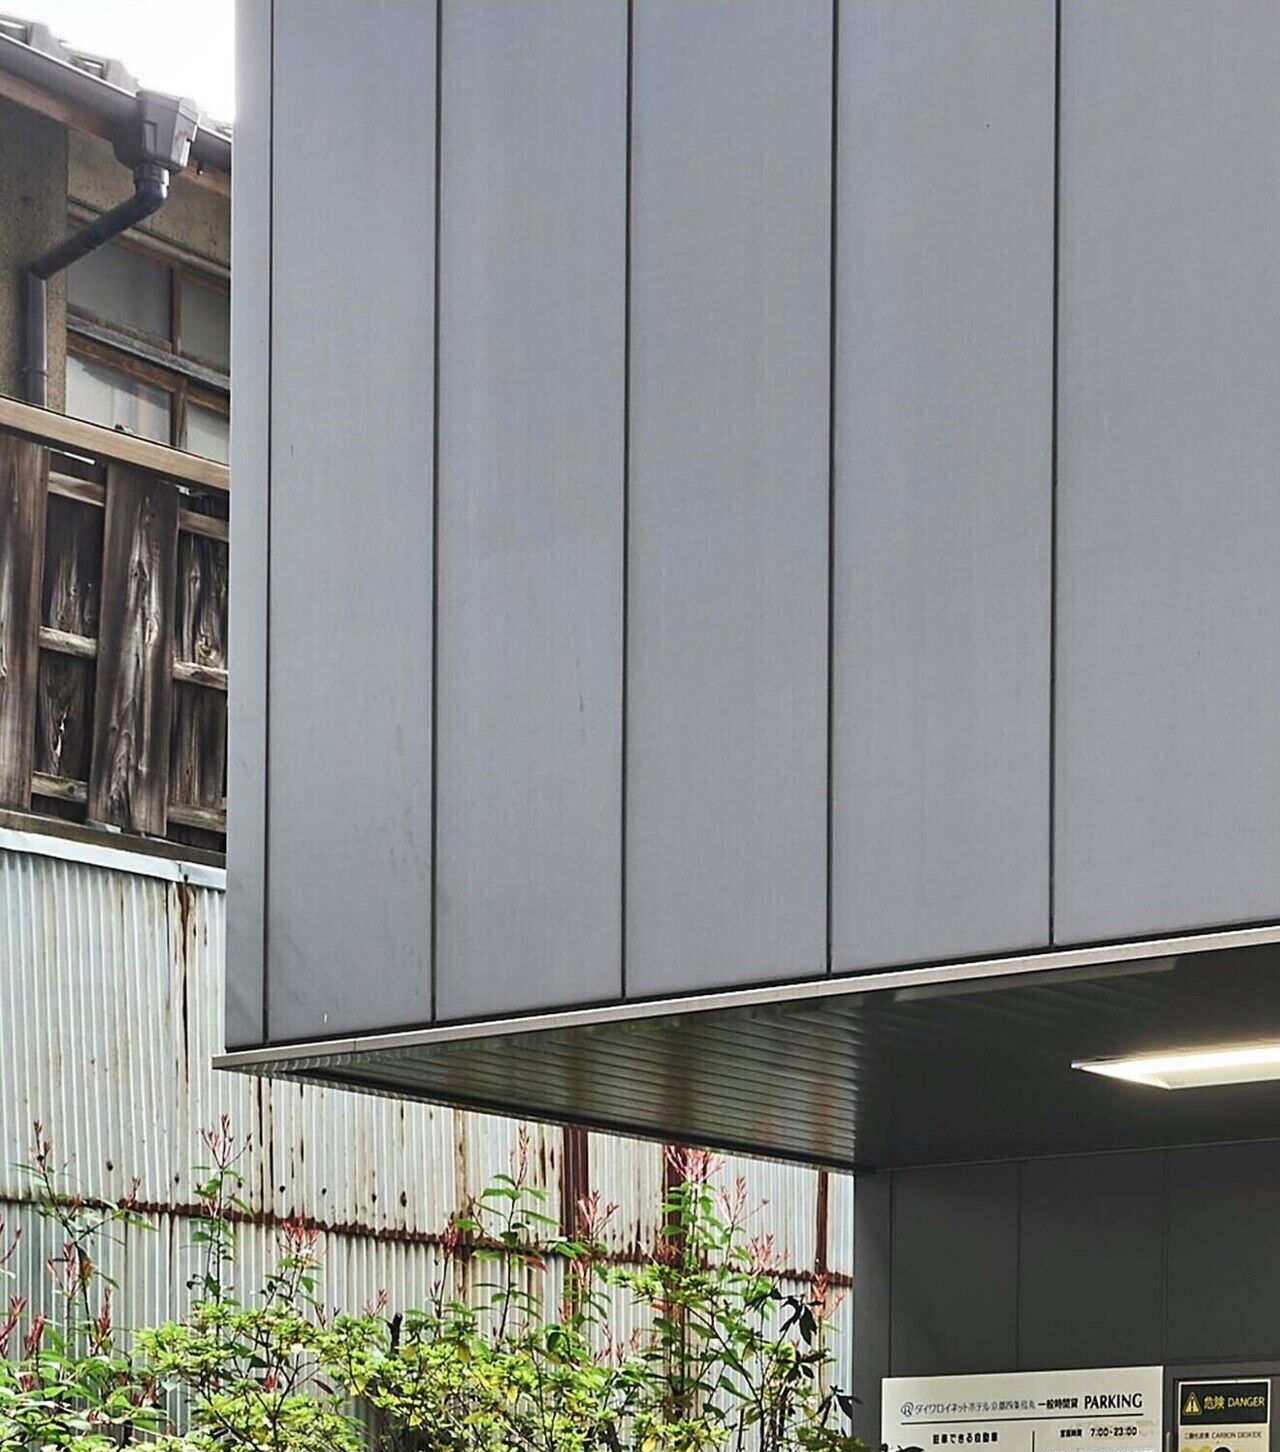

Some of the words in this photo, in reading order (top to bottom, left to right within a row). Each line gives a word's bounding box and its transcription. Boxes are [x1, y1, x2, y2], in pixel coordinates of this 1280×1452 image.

[1084, 1393, 1143, 1410] PARKING
[1203, 1394, 1226, 1411] 危険
[1228, 1396, 1265, 1408] DANGER
